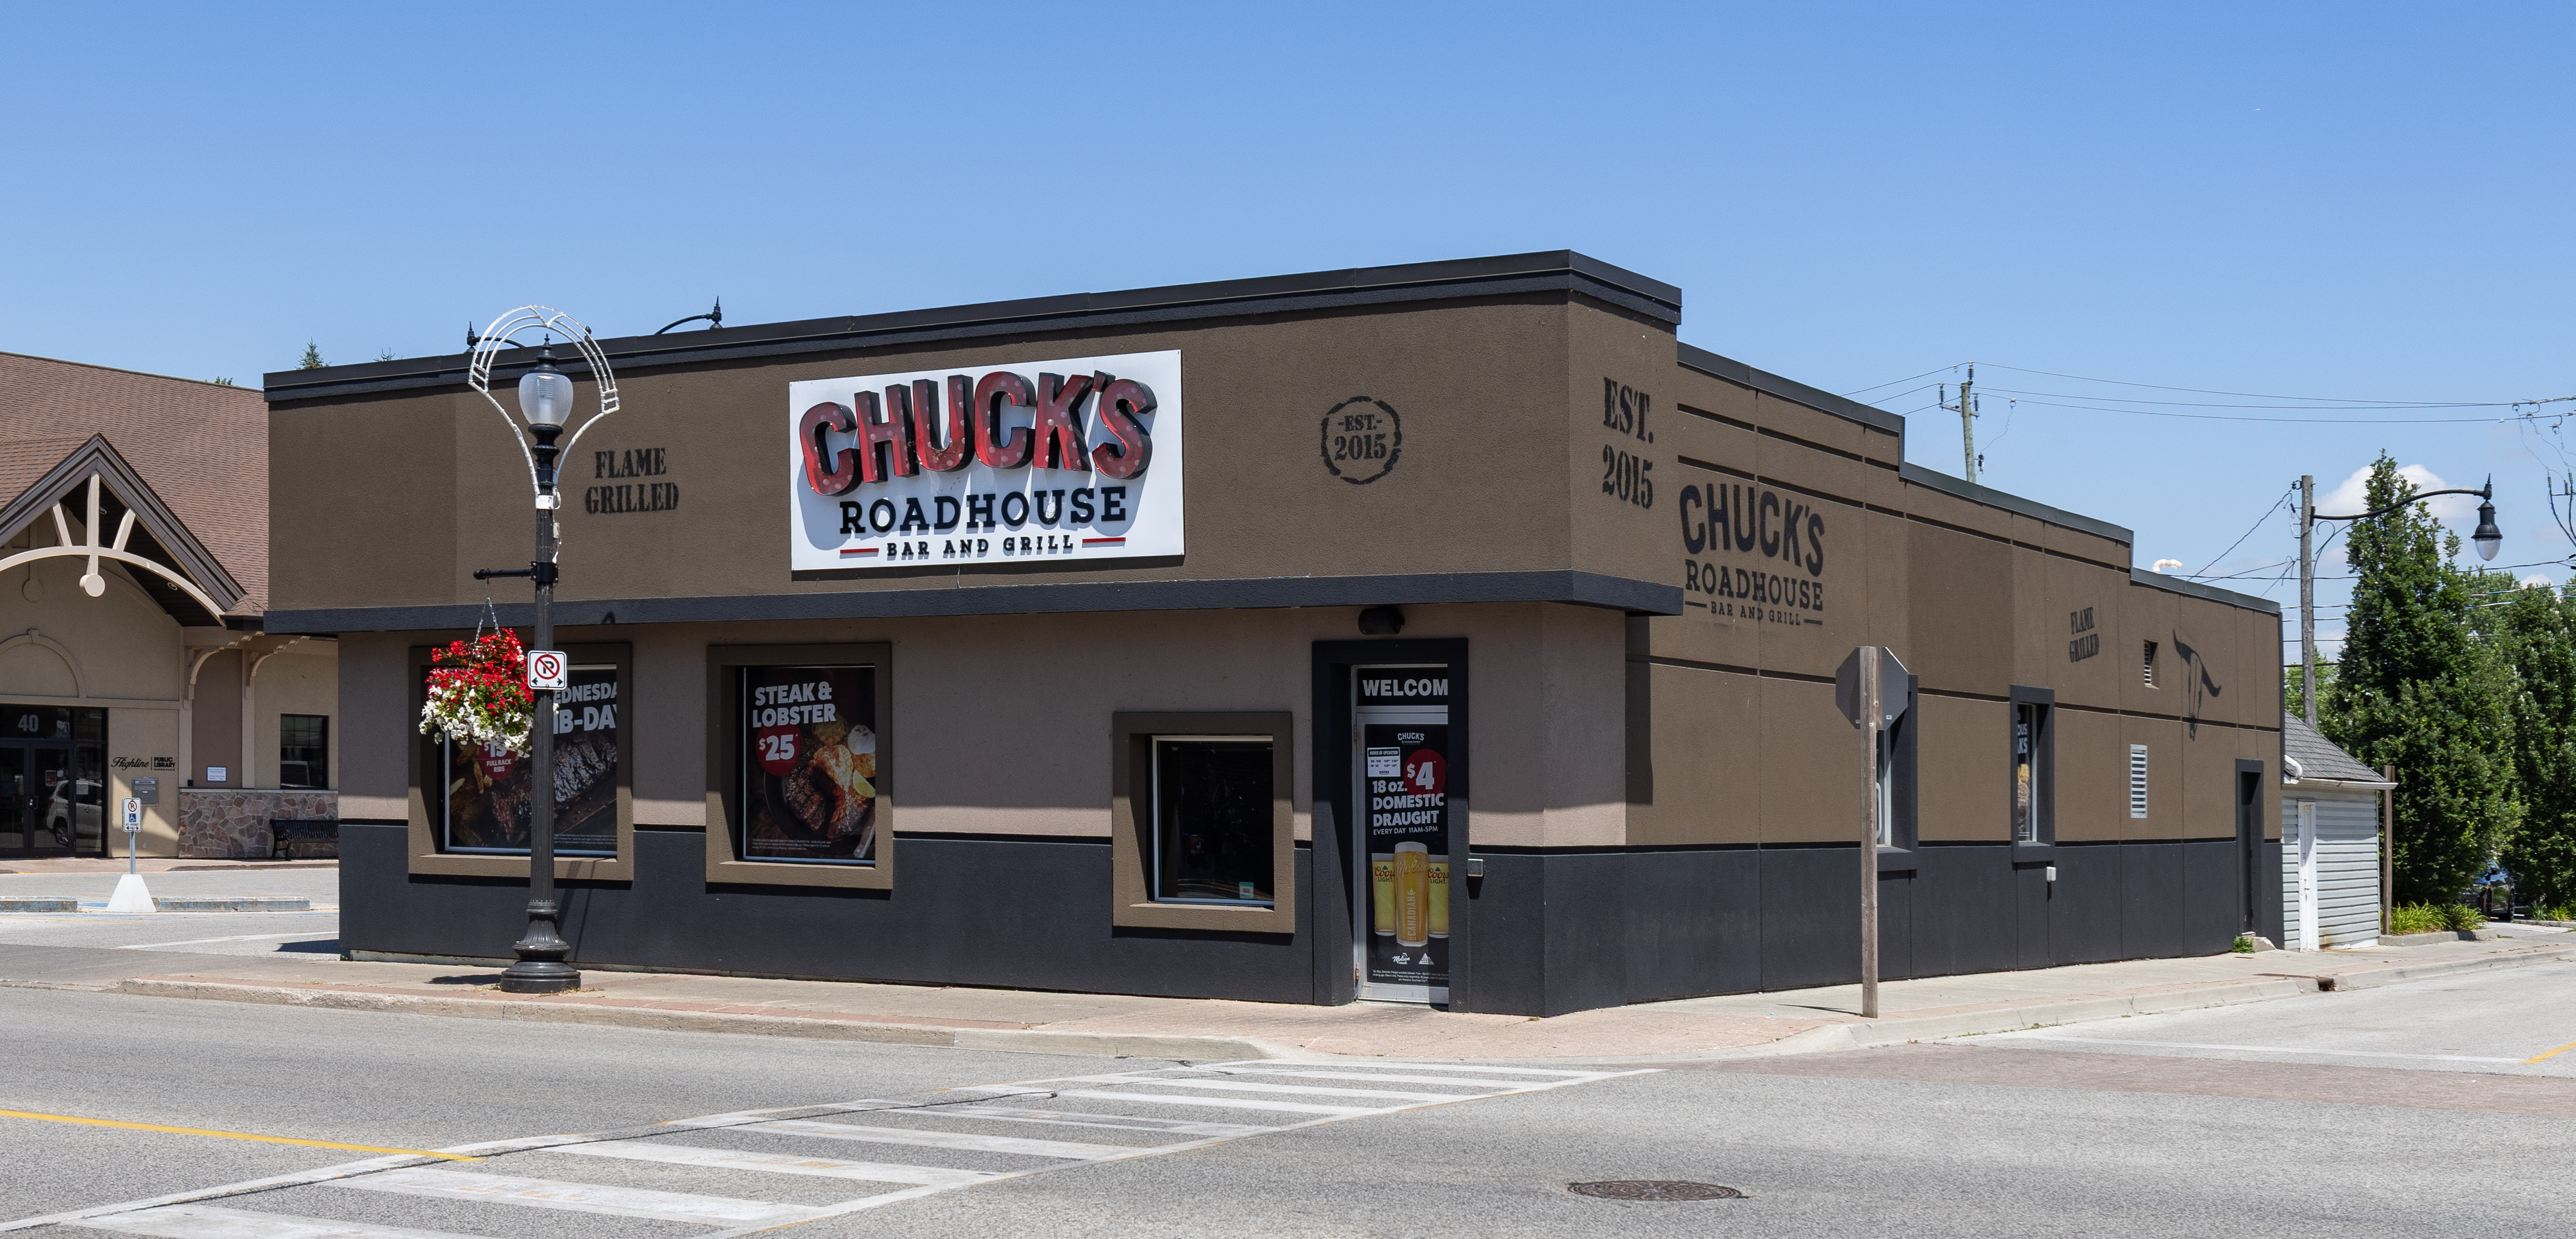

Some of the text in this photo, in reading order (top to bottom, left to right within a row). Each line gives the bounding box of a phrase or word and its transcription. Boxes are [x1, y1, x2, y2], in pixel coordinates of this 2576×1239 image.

[1603, 377, 1654, 444] EST.
[800, 370, 1157, 496] CHUCK'S
[1334, 433, 1387, 460] 2015
[595, 448, 667, 478] FLAME
[1602, 444, 1653, 509] 2015
[585, 482, 679, 515] GRILLED
[839, 486, 1126, 534] ROADHOUSE
[1680, 483, 1825, 577] CHUCK'S
[887, 535, 1073, 558] BAR AND GRILL
[1685, 559, 1823, 611] ROADHOUSE
[1711, 601, 1800, 626] BAR AND GRILL
[2070, 607, 2095, 634] FLAME
[2069, 633, 2100, 663] GRILLED
[755, 681, 832, 706] STEAK &
[1363, 679, 1448, 696] WELCOM
[18, 715, 39, 732] 40
[752, 704, 836, 728] LOBSTER
[1398, 732, 1425, 741] CHUCK'S
[110, 756, 149, 771] Highline
[1373, 780, 1386, 794] 18
[1373, 793, 1444, 810] DOMESTIC
[1373, 810, 1439, 827] DRAUGHT
[1407, 896, 1416, 936] CANADIAN
